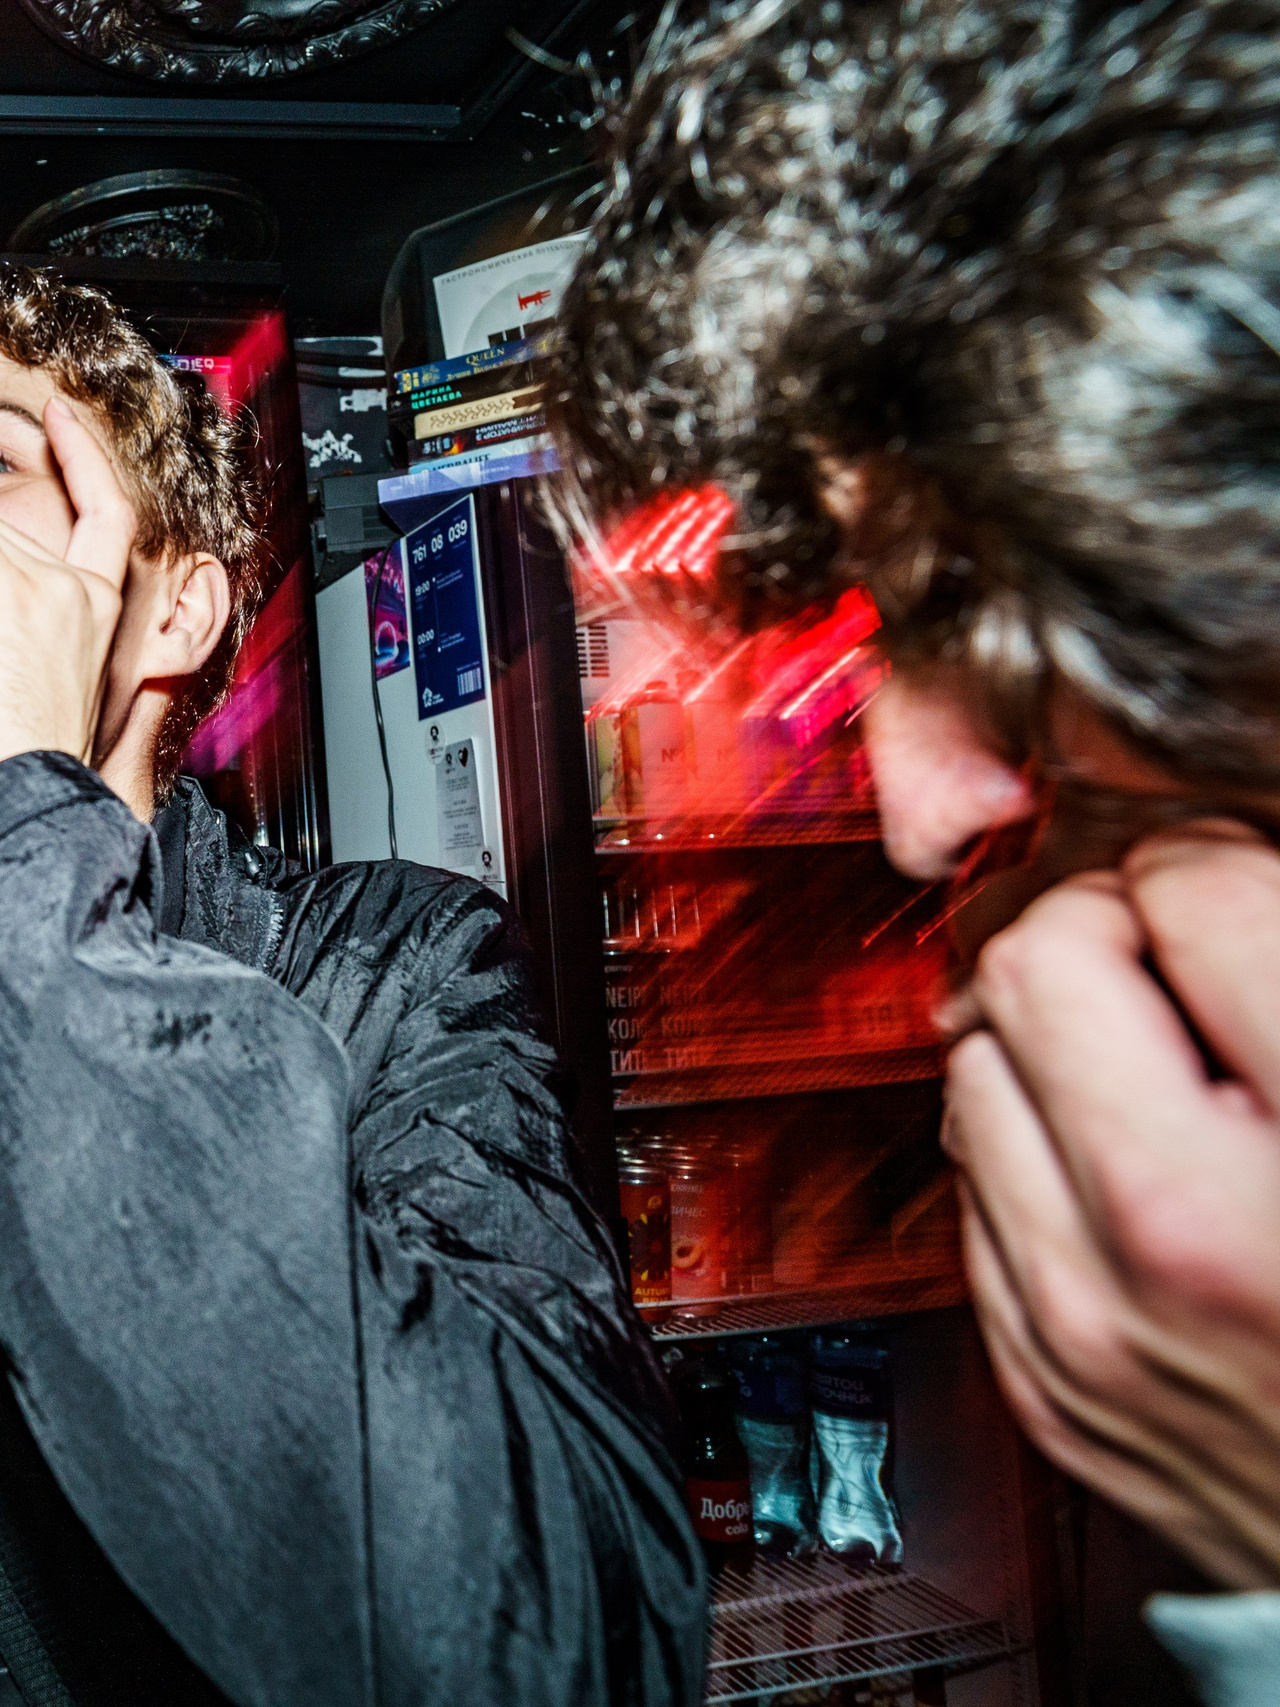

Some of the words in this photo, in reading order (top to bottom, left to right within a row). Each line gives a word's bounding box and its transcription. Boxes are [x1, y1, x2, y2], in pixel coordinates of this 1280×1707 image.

[465, 347, 505, 366] QUEEN
[411, 385, 452, 401] МАРИНА
[411, 391, 462, 410] ЦВЕТАЕВА
[412, 544, 427, 565] 761
[431, 534, 444, 553] 08
[448, 519, 468, 543] 039
[417, 629, 435, 646] 00:00
